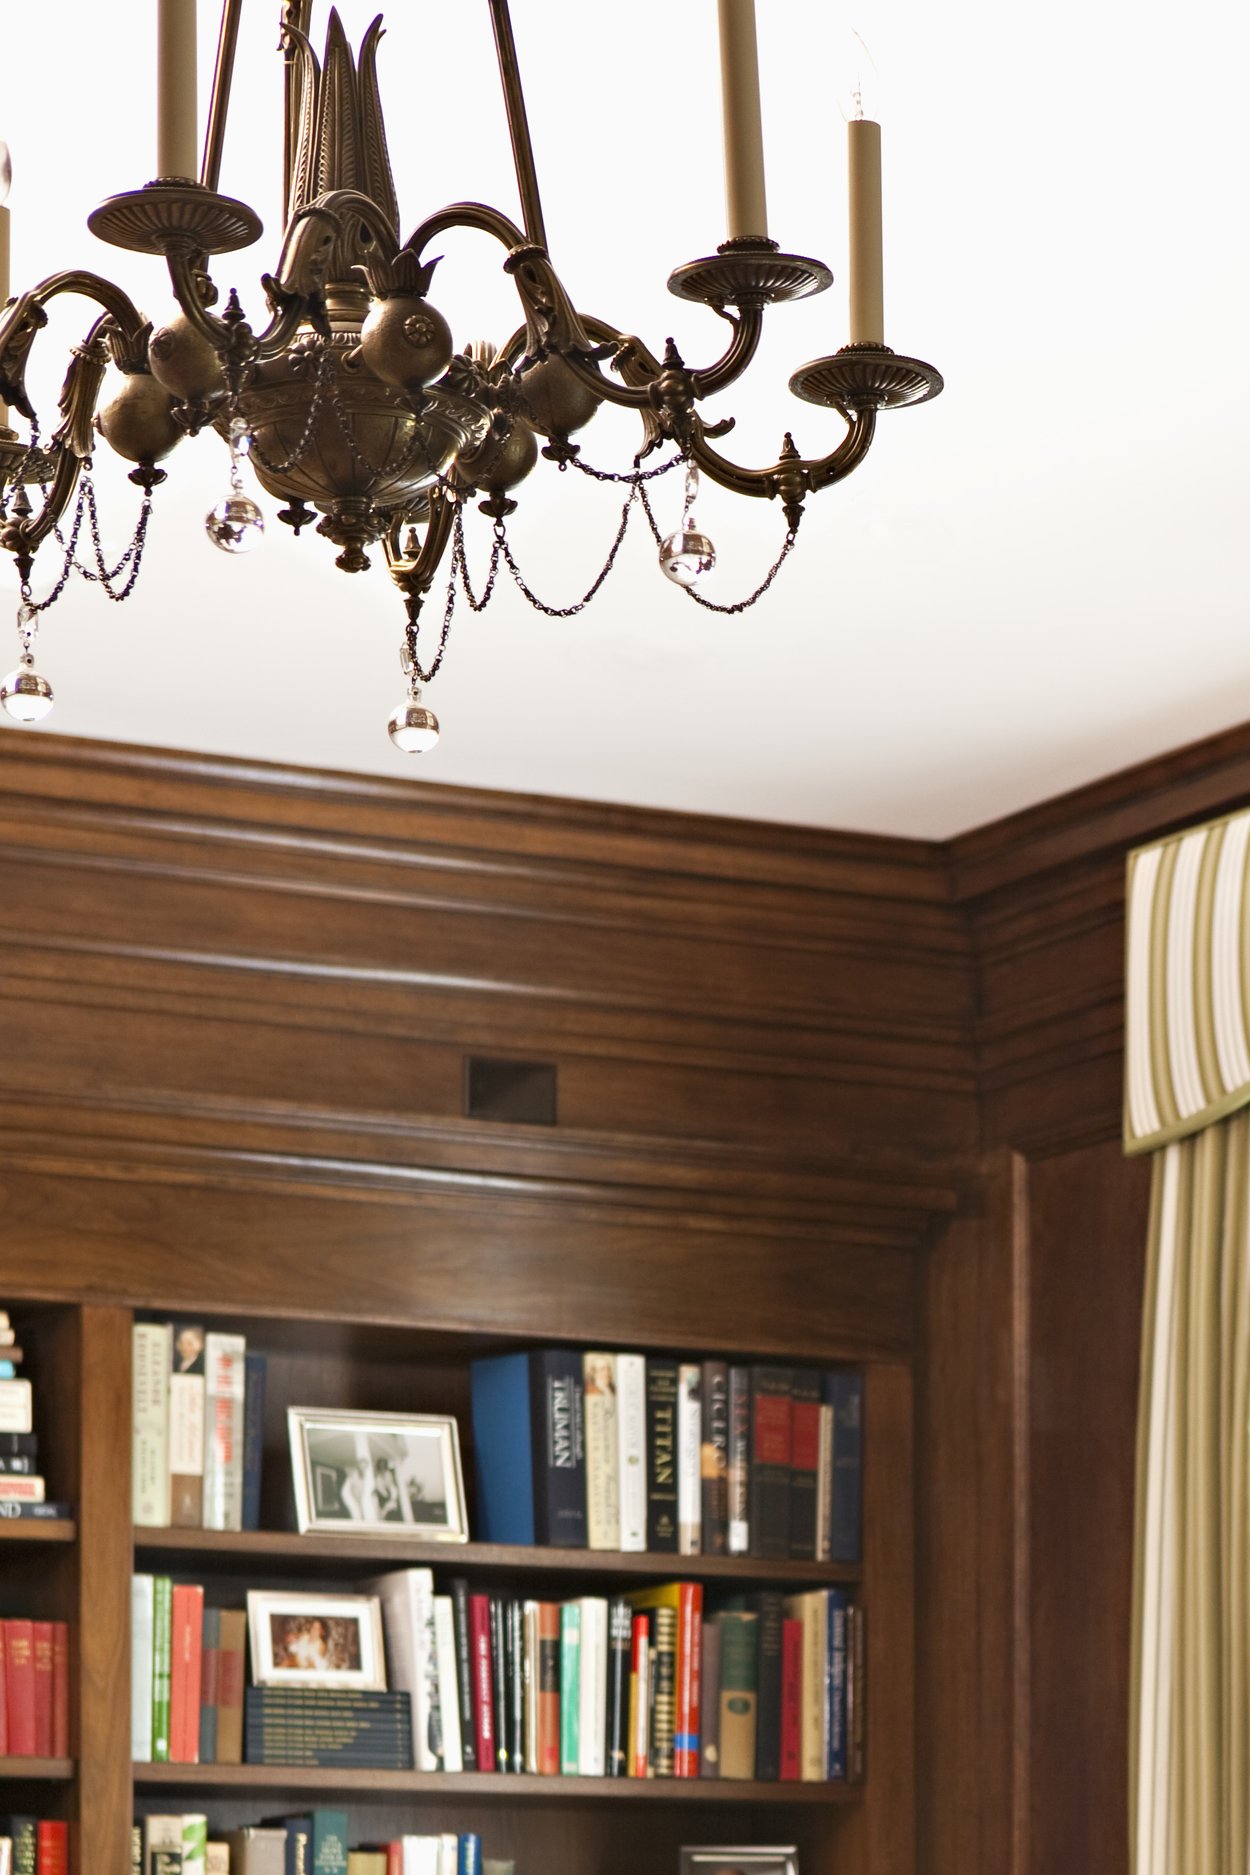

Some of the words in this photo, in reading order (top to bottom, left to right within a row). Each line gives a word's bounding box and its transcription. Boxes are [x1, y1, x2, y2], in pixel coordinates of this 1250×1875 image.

[552, 1378, 569, 1468] TRUMAN
[654, 1407, 673, 1484] TITAN
[711, 1374, 726, 1468] CICERO
